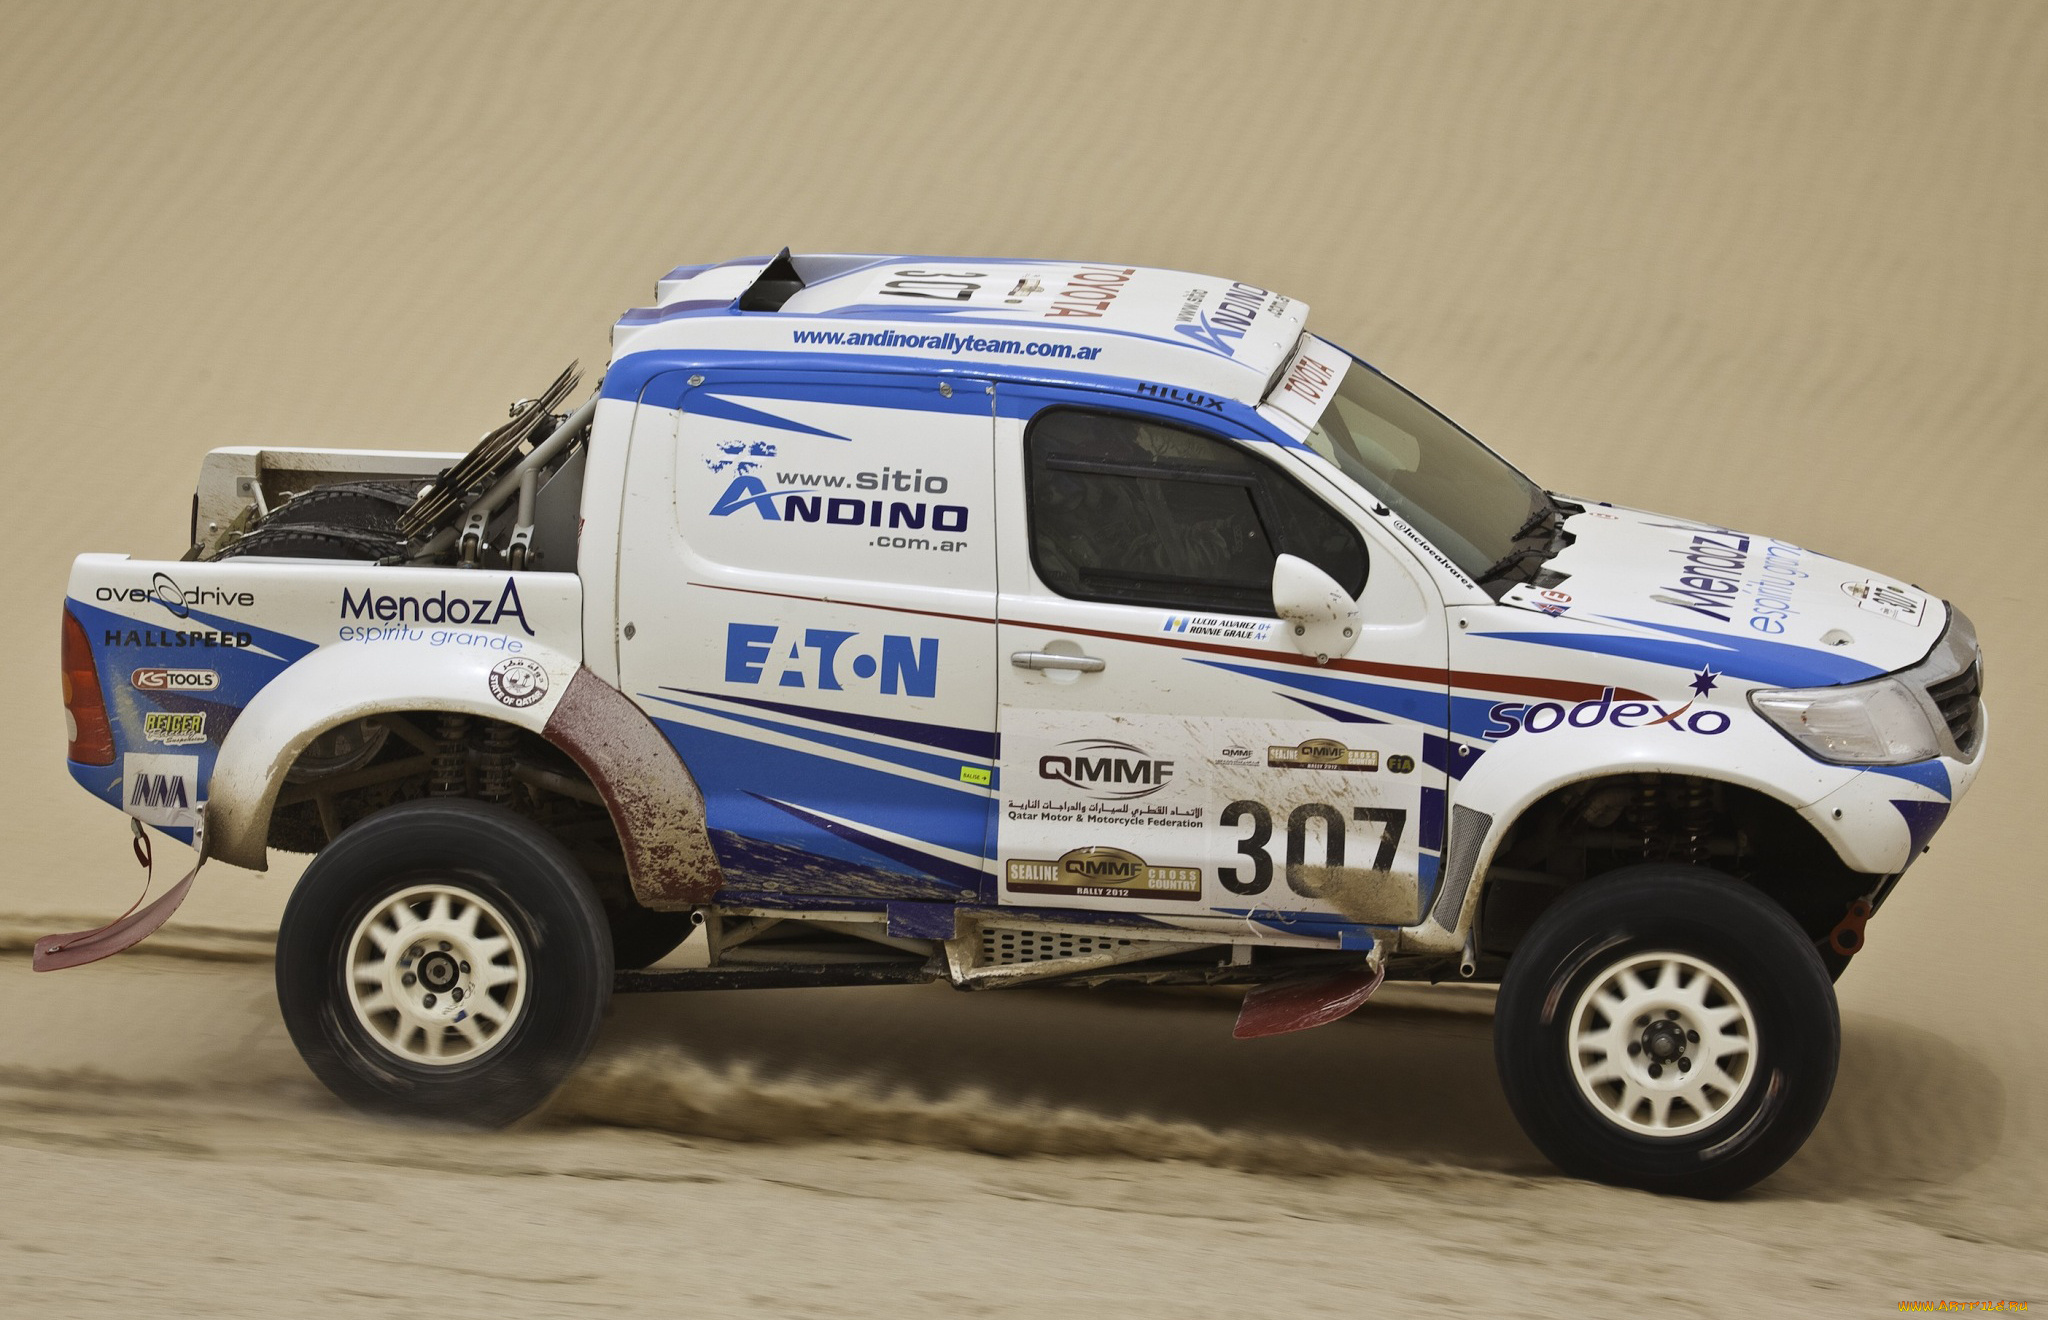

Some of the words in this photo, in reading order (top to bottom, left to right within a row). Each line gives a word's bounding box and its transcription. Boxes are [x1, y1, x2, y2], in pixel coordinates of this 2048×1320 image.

[1044, 266, 1137, 318] TOYOTA
[1174, 282, 1269, 357] ANDINO
[793, 329, 1103, 361] www.andinorallyteam.com.ar
[1284, 355, 1334, 405] TOYOTA
[1136, 383, 1226, 412] HILUX
[776, 467, 949, 494] www.sitio
[708, 475, 969, 532] ANDINO
[869, 536, 968, 552] .com.ar
[1192, 617, 1218, 626] LUCIO
[1219, 620, 1257, 630] ALVAREZ
[105, 630, 253, 648] HALLSPEED
[339, 622, 424, 644] espíritu
[430, 630, 523, 653] grande
[1189, 626, 1222, 637] RONNIE
[1223, 629, 1254, 639] GRAUE
[1254, 632, 1267, 640] A+
[725, 622, 939, 698] EATON
[138, 671, 167, 687] KS
[167, 673, 213, 686] TOOLS
[490, 674, 505, 700] STATE
[503, 695, 516, 705] OF
[515, 690, 543, 706] QATAR
[1482, 686, 1732, 740] sodexo
[146, 714, 202, 732] REIGER
[1222, 749, 1254, 758] QMMF
[1301, 746, 1345, 757] QMMF
[1039, 755, 1175, 789] QMMF
[1008, 811, 1038, 820] Qatar
[1041, 812, 1073, 822] Motor
[1076, 814, 1083, 822] &
[1087, 814, 1144, 826] Motorcycle
[1147, 817, 1203, 828] Federation
[1218, 800, 1407, 899] 307
[1010, 864, 1059, 881] SEALINE
[1065, 860, 1142, 878] QMMF
[1148, 868, 1196, 881] CROSS
[1076, 887, 1104, 896] RALLY
[1105, 888, 1130, 897] 2012
[1148, 879, 1196, 890] COUNTRY
